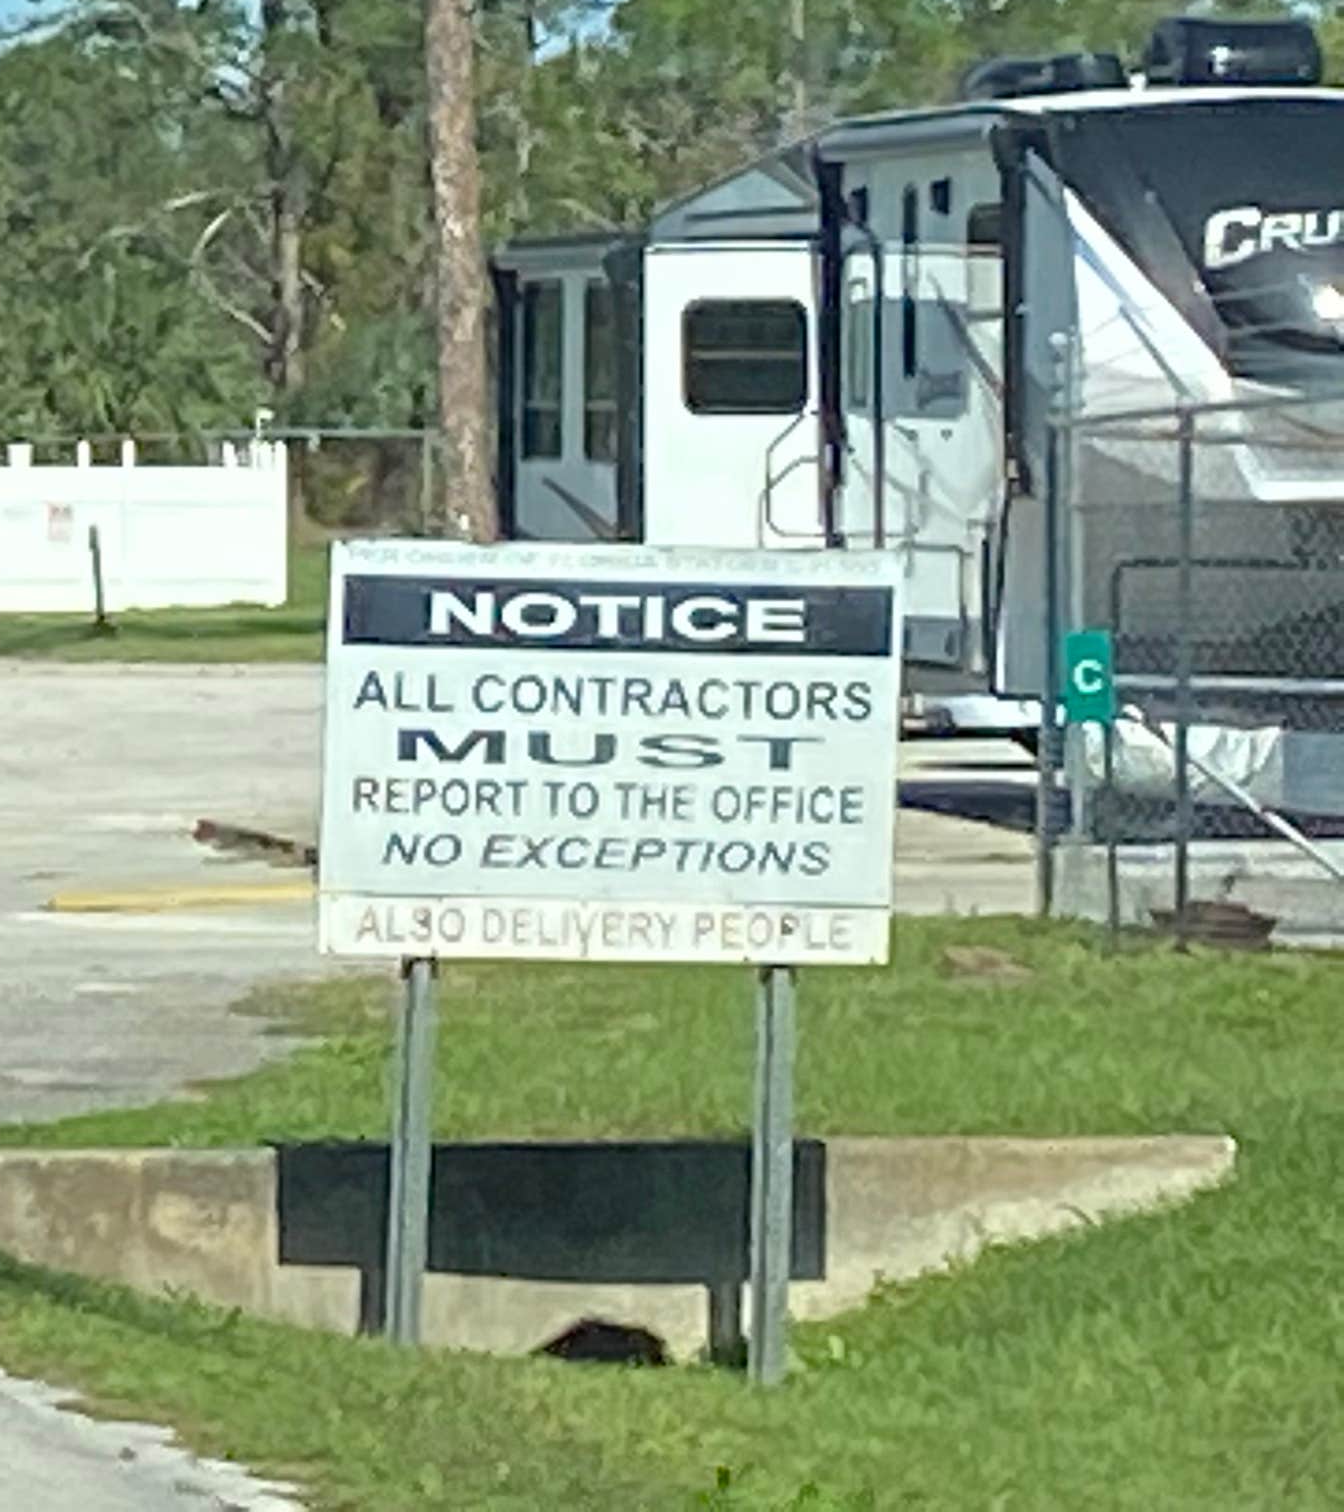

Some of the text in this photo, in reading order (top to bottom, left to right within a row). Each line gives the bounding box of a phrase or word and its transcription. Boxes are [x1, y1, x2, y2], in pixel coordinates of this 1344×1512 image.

[427, 591, 806, 642] NOTICE
[352, 671, 873, 721] ALL CONTRACTORS
[1073, 659, 1103, 693] C
[396, 728, 825, 771] MUST
[352, 779, 864, 825] REPORT TO THE OFFICE
[381, 832, 832, 876] NO EXCEPTIONS
[355, 905, 853, 951] ALSO DELIVERY PEOPLE
